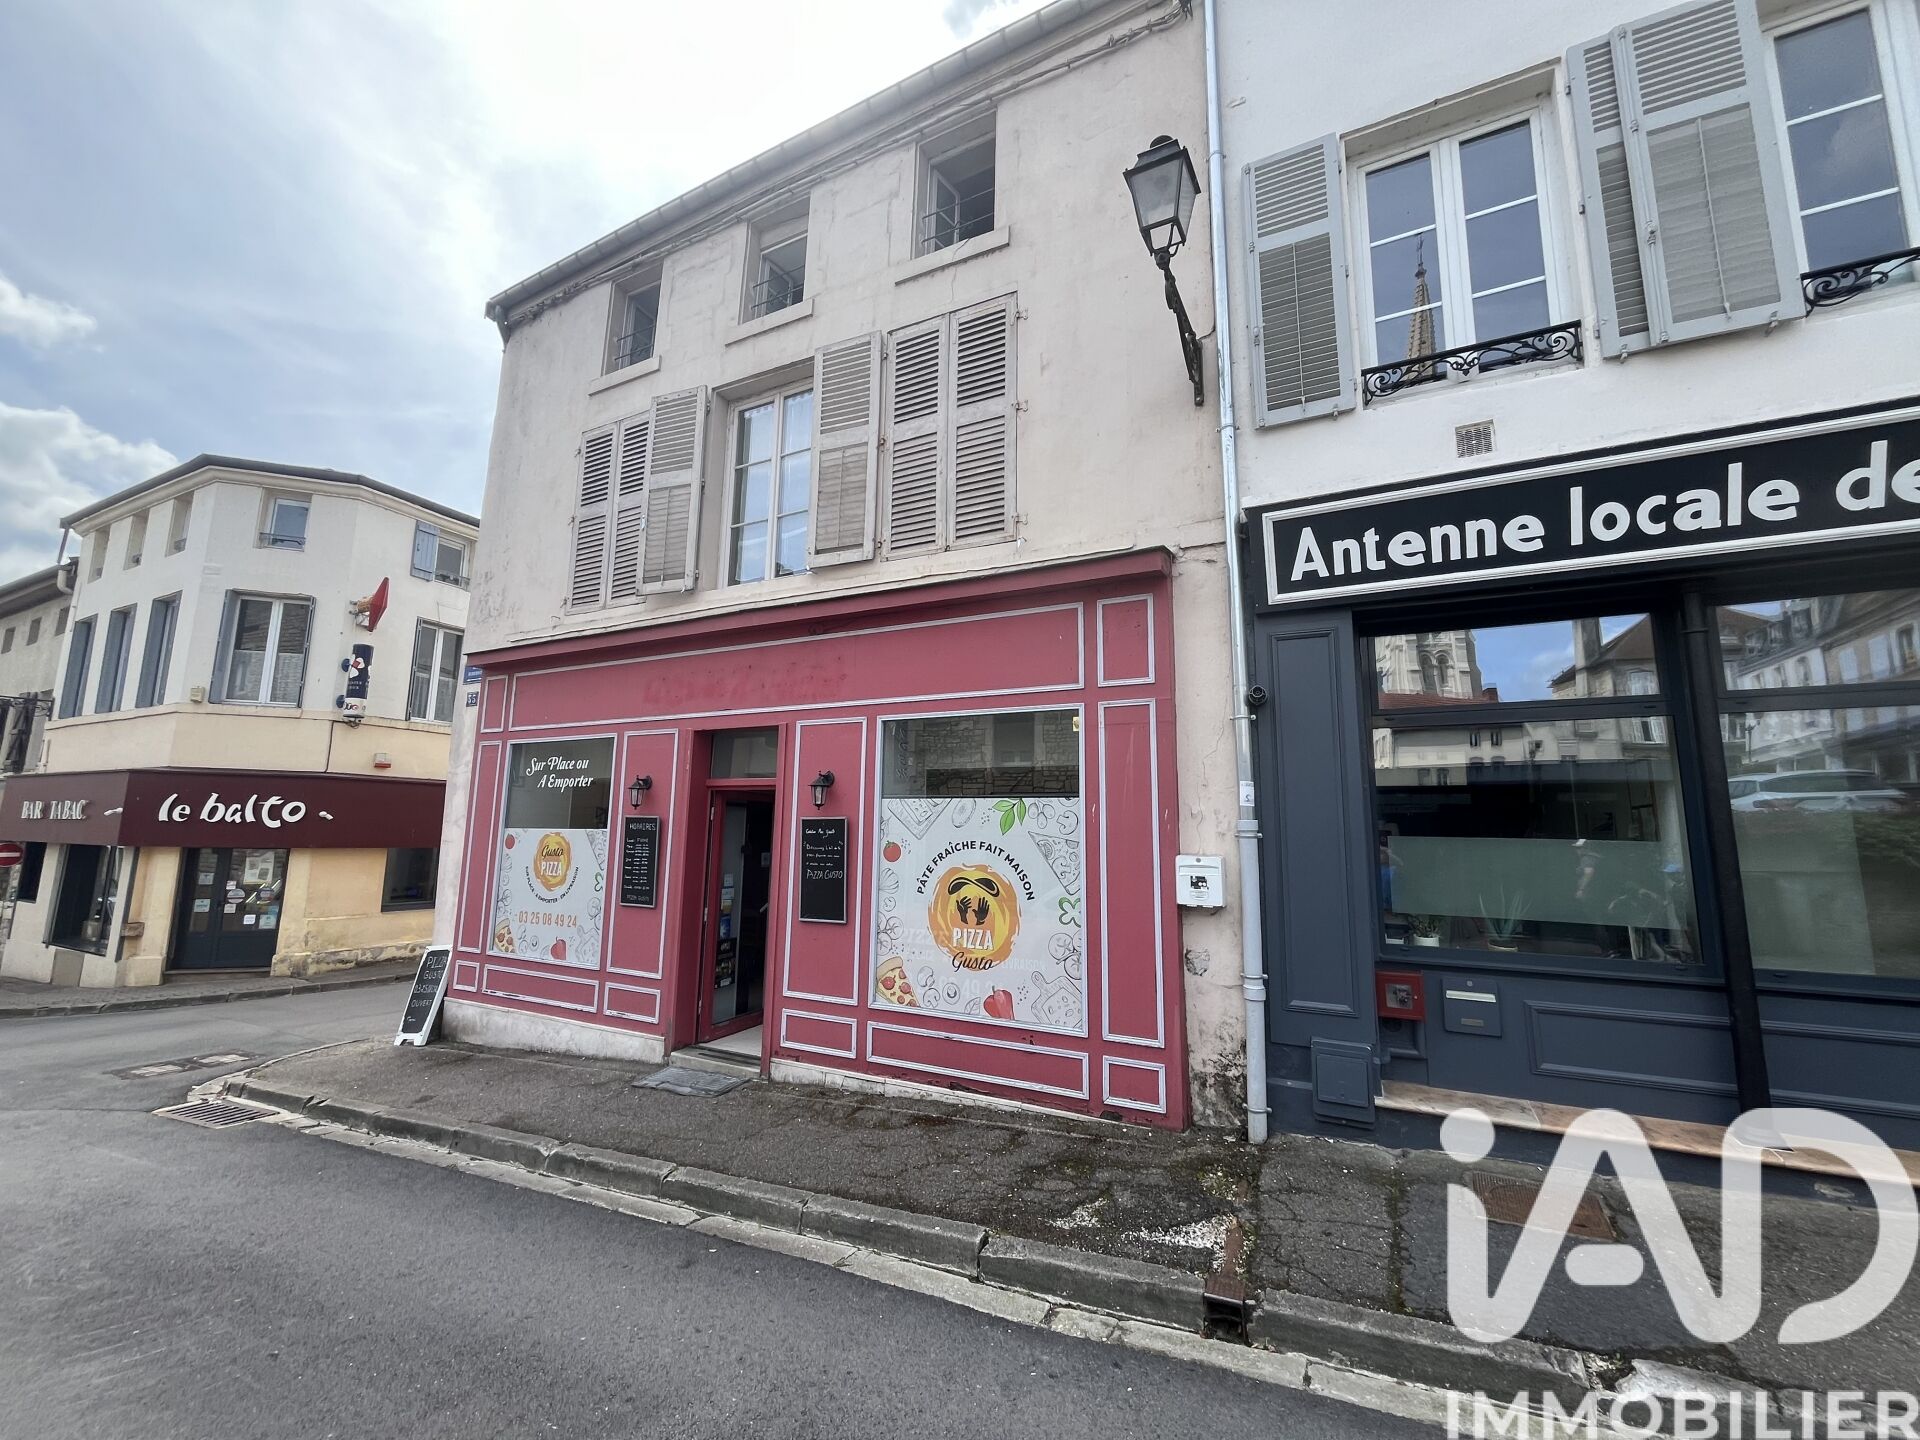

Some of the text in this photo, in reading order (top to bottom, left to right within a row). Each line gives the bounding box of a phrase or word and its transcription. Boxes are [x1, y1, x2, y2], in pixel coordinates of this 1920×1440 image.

[1290, 440, 1920, 581] Antenne locale de
[526, 756, 590, 776] Sur Place ou
[537, 774, 593, 793] A Emporter
[21, 800, 87, 820] BAR TABAC
[158, 793, 191, 822] le
[540, 861, 562, 877] PIZZA
[917, 839, 1036, 901] PÂTE FRAÎCHE FAIT MAISON
[518, 911, 577, 928] 03 25 08 49 24
[953, 927, 994, 951] PIZZA
[952, 951, 993, 973] Gusto
